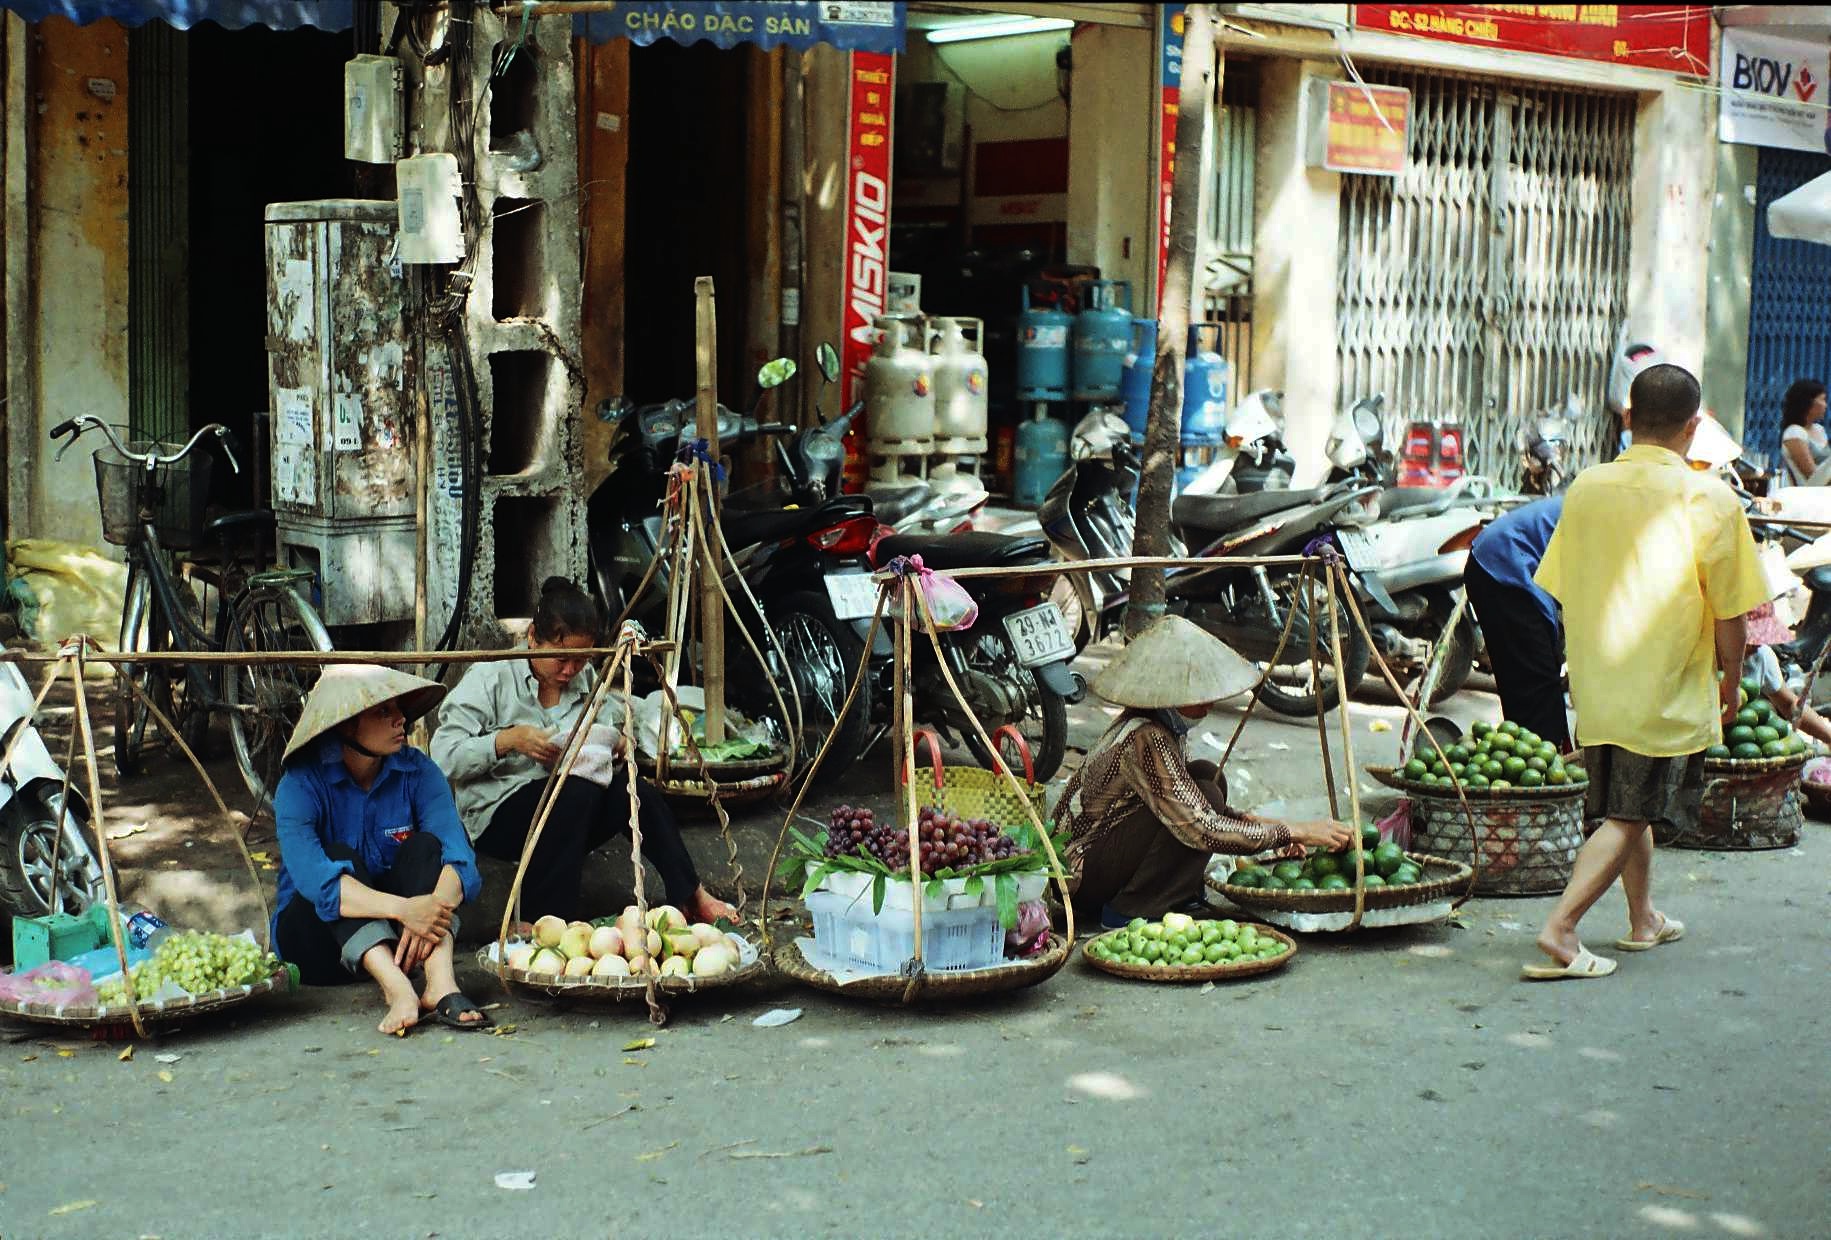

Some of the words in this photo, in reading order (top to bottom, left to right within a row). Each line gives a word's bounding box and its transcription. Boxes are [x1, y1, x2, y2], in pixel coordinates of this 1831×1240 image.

[1732, 53, 1792, 96] BIDV
[850, 171, 886, 345] MISKIO
[1024, 629, 1066, 657] 3672
